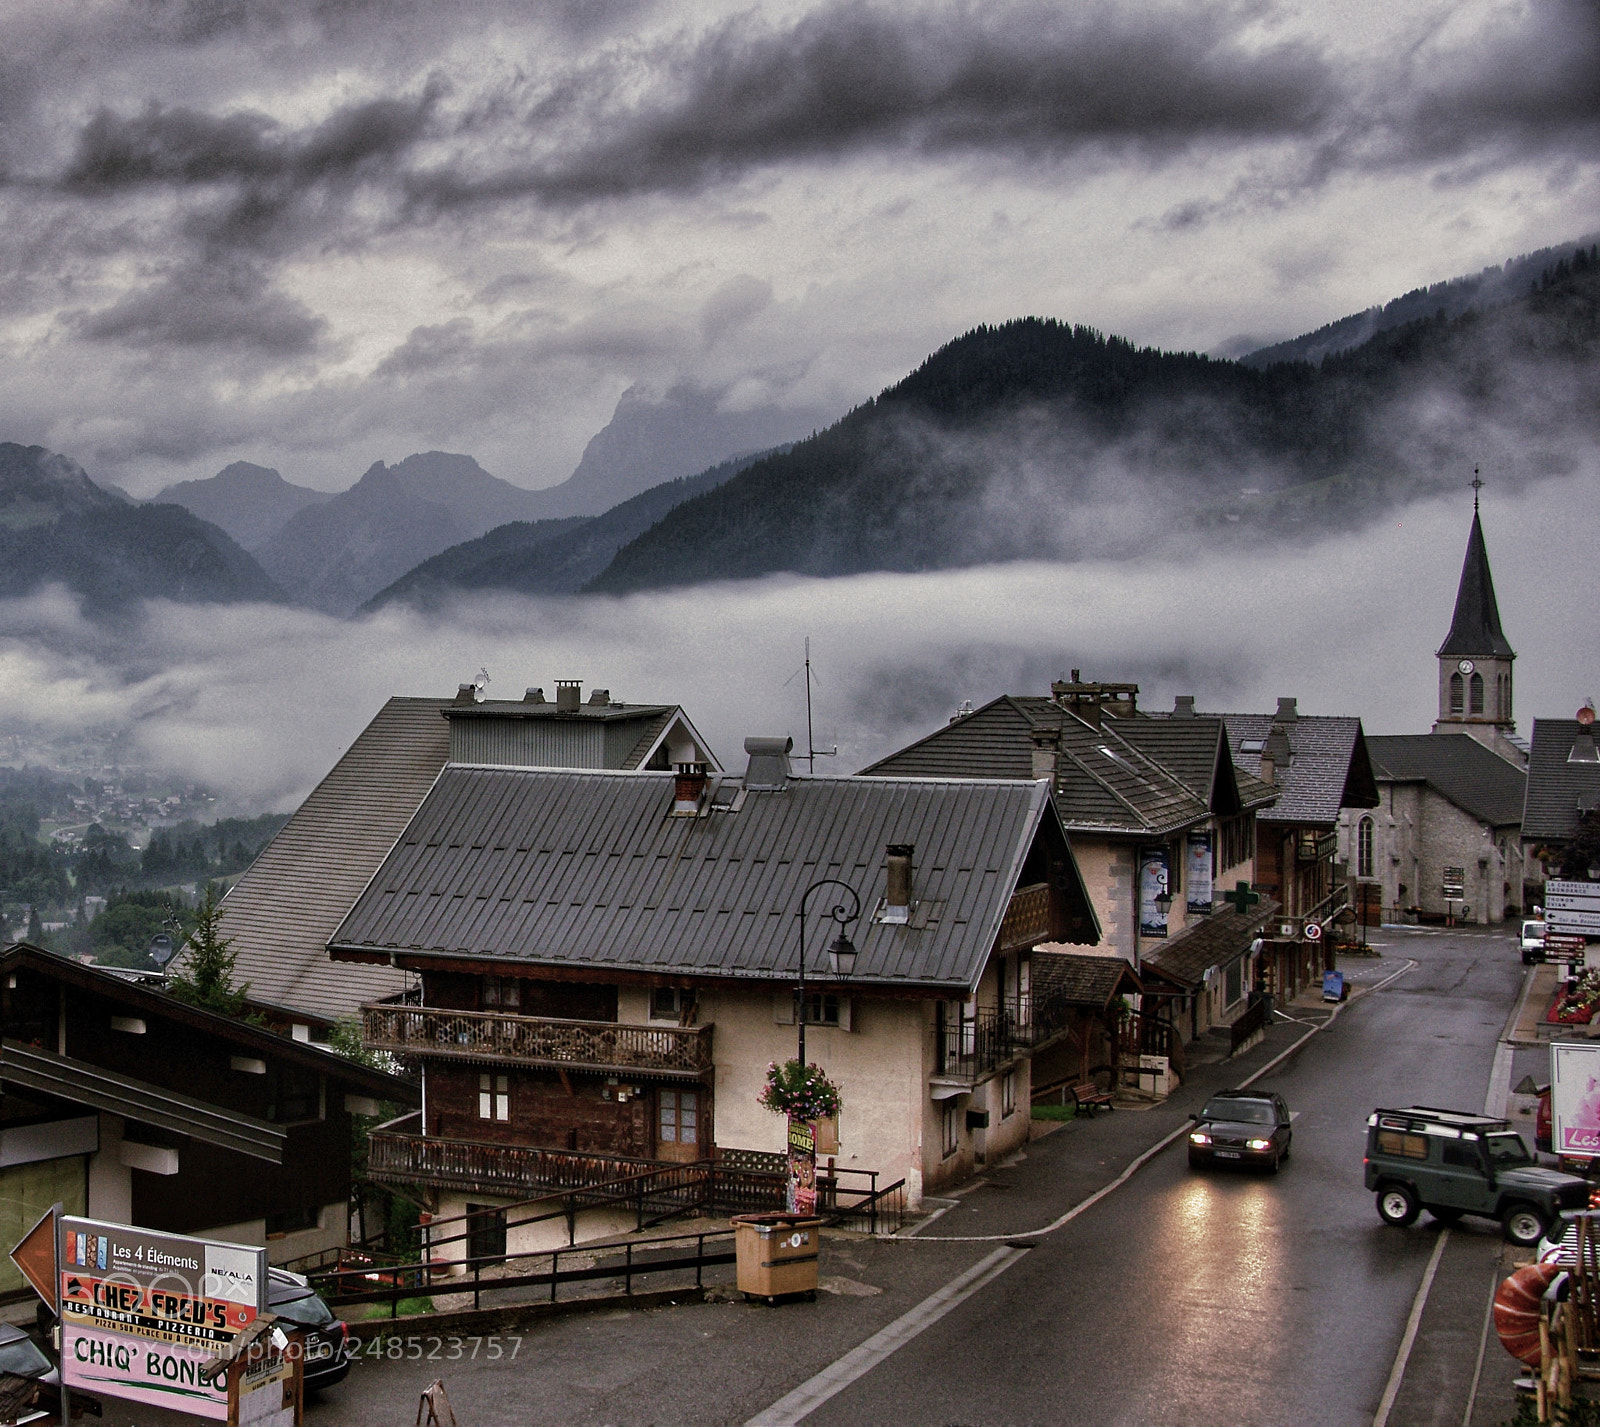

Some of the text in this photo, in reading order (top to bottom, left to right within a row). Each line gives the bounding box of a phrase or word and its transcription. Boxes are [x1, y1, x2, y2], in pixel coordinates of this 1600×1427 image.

[1568, 1129, 1600, 1147] Les
[113, 1244, 199, 1270] Les 4 Éléments
[67, 1302, 215, 1339] RESTAURANT PIZZERIA
[93, 1282, 228, 1328] CHEZ FRED'S
[95, 1318, 117, 1329] PIZZA
[119, 1322, 134, 1333] SUR
[136, 1326, 160, 1338] PLACE
[163, 1332, 173, 1340] OU
[74, 1337, 138, 1373] CHIQ'
